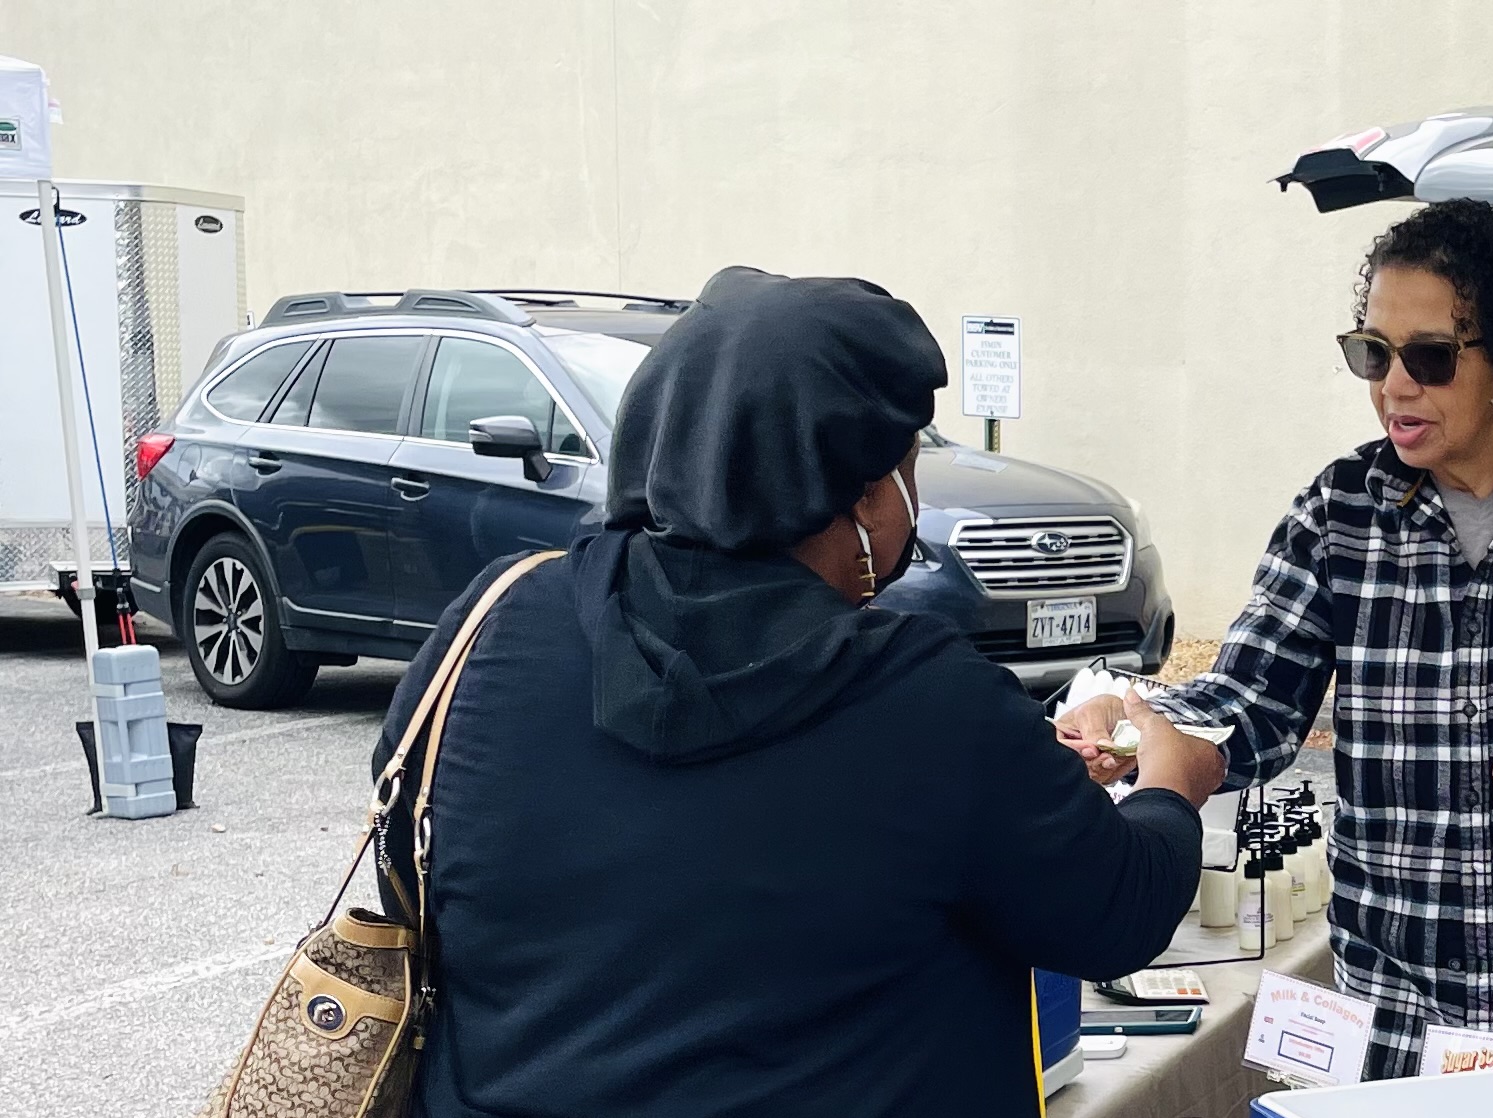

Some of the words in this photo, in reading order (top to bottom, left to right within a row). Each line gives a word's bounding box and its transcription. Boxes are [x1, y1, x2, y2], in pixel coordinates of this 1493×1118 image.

[971, 350, 1011, 359] CUSTOMER
[965, 359, 997, 369] PARKING
[999, 361, 1017, 370] ONLY
[1270, 989, 1297, 1003] Milk
[1301, 991, 1309, 1003] &
[1314, 994, 1364, 1029] Collagen
[1442, 1049, 1479, 1075] Sugar
